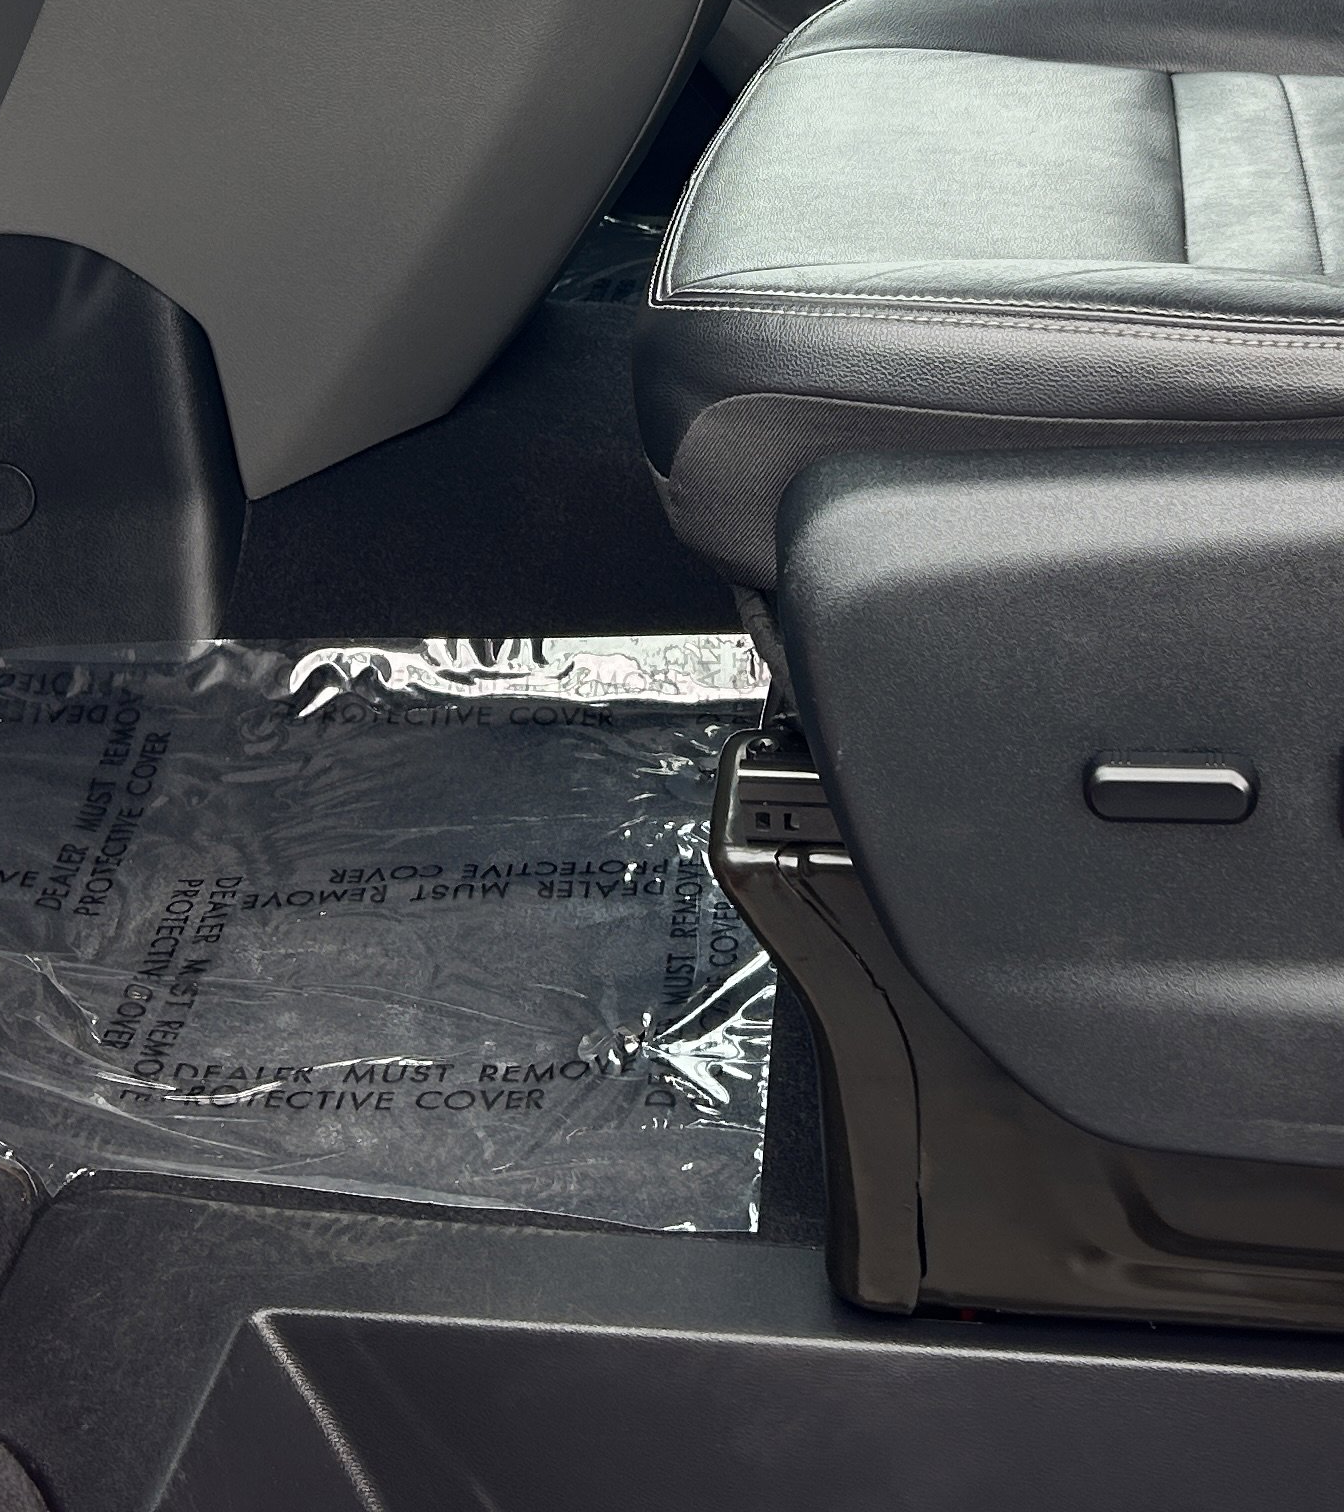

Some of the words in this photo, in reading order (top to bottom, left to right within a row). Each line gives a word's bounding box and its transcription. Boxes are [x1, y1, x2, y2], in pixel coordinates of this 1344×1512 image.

[509, 705, 615, 728] COVER
[72, 807, 145, 917] PROTECTIVE
[126, 731, 172, 796] COVER
[34, 843, 89, 912] DEALER
[72, 776, 116, 834] MUST
[329, 863, 444, 885] COVER
[460, 858, 670, 881] PROTECTIVE
[241, 888, 388, 911] REMOVE
[410, 883, 507, 902] MUST
[539, 882, 666, 902] DEALER
[200, 875, 243, 946] DEALER
[142, 877, 205, 979] PROTECTIV
[165, 957, 213, 1011] MST
[102, 983, 154, 1050] COVER
[342, 1061, 454, 1085] MUST
[414, 1089, 545, 1112] COVER
